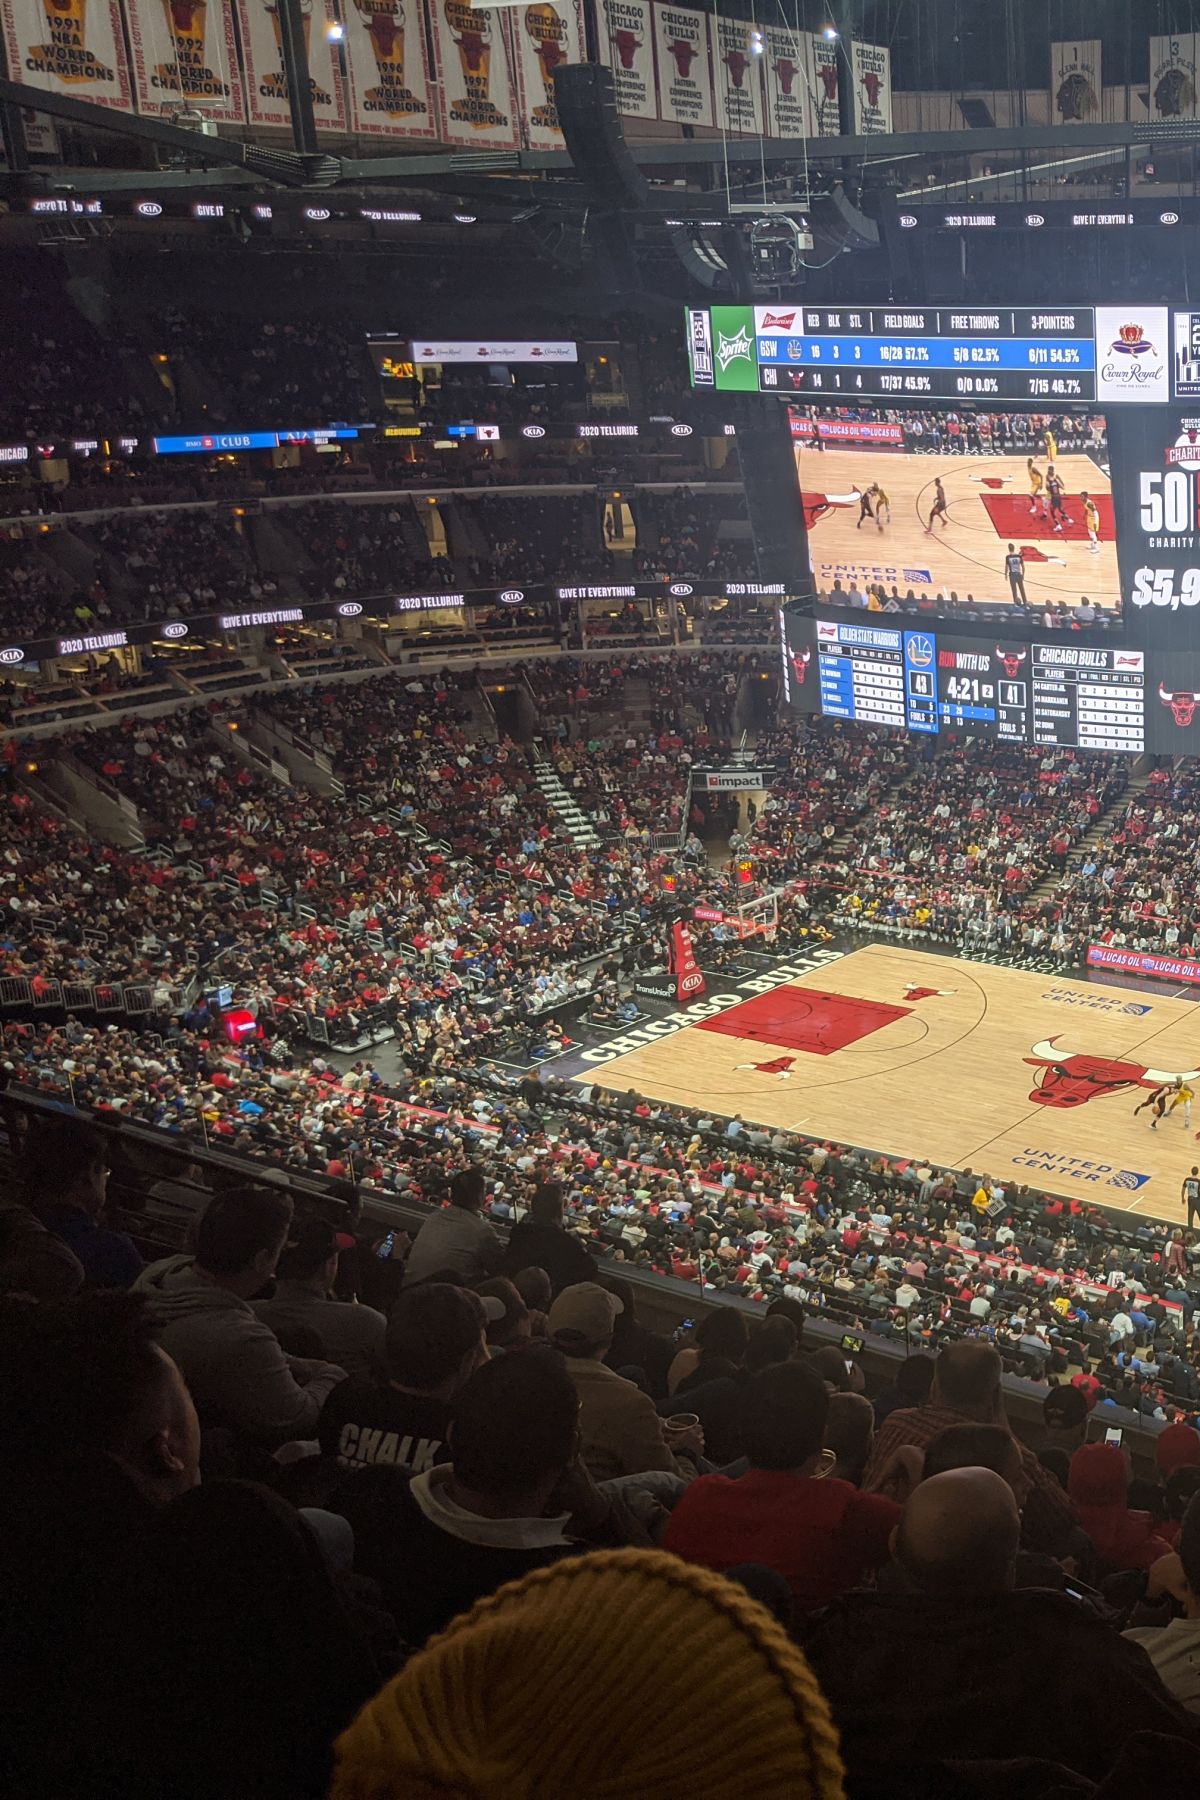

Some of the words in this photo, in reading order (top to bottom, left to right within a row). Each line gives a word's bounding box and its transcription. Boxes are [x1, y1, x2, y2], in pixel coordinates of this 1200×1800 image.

[47, 16, 80, 31] 1991
[527, 13, 568, 29] CHICAGO
[661, 11, 699, 28] CHICAGO
[51, 32, 81, 45] NBA
[534, 27, 563, 41] BULLS
[669, 26, 695, 40] BULLS
[170, 35, 203, 50] 1992
[42, 45, 95, 63] WORLD
[26, 59, 114, 82] CHAMPIONS
[165, 64, 213, 80] WORLD
[376, 62, 402, 73] 1996
[151, 76, 229, 96] CHAMPIONS
[463, 75, 487, 87] 1997
[373, 88, 413, 99] WORLD
[467, 88, 487, 99] NBA
[363, 100, 427, 113] CHAMPIONS
[460, 100, 496, 112] WORLD
[450, 111, 509, 127] CHAMPIONS
[764, 316, 794, 325] Budweiser
[808, 314, 820, 327] REB
[828, 314, 840, 327] BLK
[850, 314, 862, 328] STL
[884, 314, 902, 328] FIELD
[903, 315, 924, 328] GOALS
[951, 315, 968, 329] FREE
[969, 315, 1000, 330] THROWS
[1031, 315, 1075, 330] 3-POINTERS
[719, 339, 749, 360] Sprite
[760, 341, 778, 357] GSW
[811, 346, 820, 358] 16
[834, 346, 839, 359] 3
[855, 346, 861, 359] 3
[880, 346, 903, 361] 16/28
[905, 346, 929, 362] 57.1%
[953, 347, 969, 363] 5/8
[972, 348, 999, 363] 62.5%
[1029, 348, 1048, 364] 6/11
[1050, 349, 1080, 363] 54.5%
[1101, 363, 1129, 382] Crown
[1127, 363, 1164, 382] Royal
[764, 368, 778, 385] CHI
[812, 374, 822, 387] 14
[835, 375, 840, 387] 1
[856, 375, 862, 388] 4
[880, 375, 903, 391] 17/37
[904, 375, 931, 391] 45.9%
[957, 376, 973, 393] 0/0
[975, 377, 998, 392] 0.0%
[1029, 379, 1049, 394] 7/15
[1052, 379, 1081, 394] 46.7%
[580, 427, 599, 435] 2020
[600, 426, 638, 435] TELLURIDE
[222, 437, 250, 447] CLUB
[1140, 471, 1188, 532] 50
[1149, 536, 1194, 549] CHARITY
[727, 584, 745, 593] 2020
[747, 584, 785, 593] TELLURIDE
[223, 616, 241, 628] GIVE
[242, 615, 250, 625] IT
[252, 609, 303, 627] EVERYTHING
[167, 626, 185, 635] KIA
[61, 639, 82, 653] 2020
[84, 632, 128, 652] TELLURIDE
[3, 651, 21, 661] KIA
[939, 651, 955, 668] RUN
[956, 653, 976, 671] WITH
[977, 655, 990, 672] US
[1040, 648, 1078, 665] CHICAGO
[1079, 651, 1108, 667] BULLS
[915, 675, 927, 693] 43
[947, 676, 979, 700] 4:21
[1007, 685, 1018, 704] 41
[718, 775, 762, 788] impact
[1102, 951, 1126, 964] LUCAS
[1127, 955, 1140, 967] OIL
[1154, 960, 1179, 973] LUCAS
[1181, 964, 1195, 977] OIL
[635, 983, 671, 998] TransUnion
[683, 976, 701, 989] KIA
[1041, 993, 1114, 1011] CENTER
[1050, 987, 1122, 1006] UNITED
[581, 993, 743, 1063] CHICAGO
[736, 949, 845, 992] BULLS
[1011, 1156, 1100, 1182] CENTER
[1023, 1148, 1113, 1174] UNITED
[338, 1421, 443, 1475] CHALK
